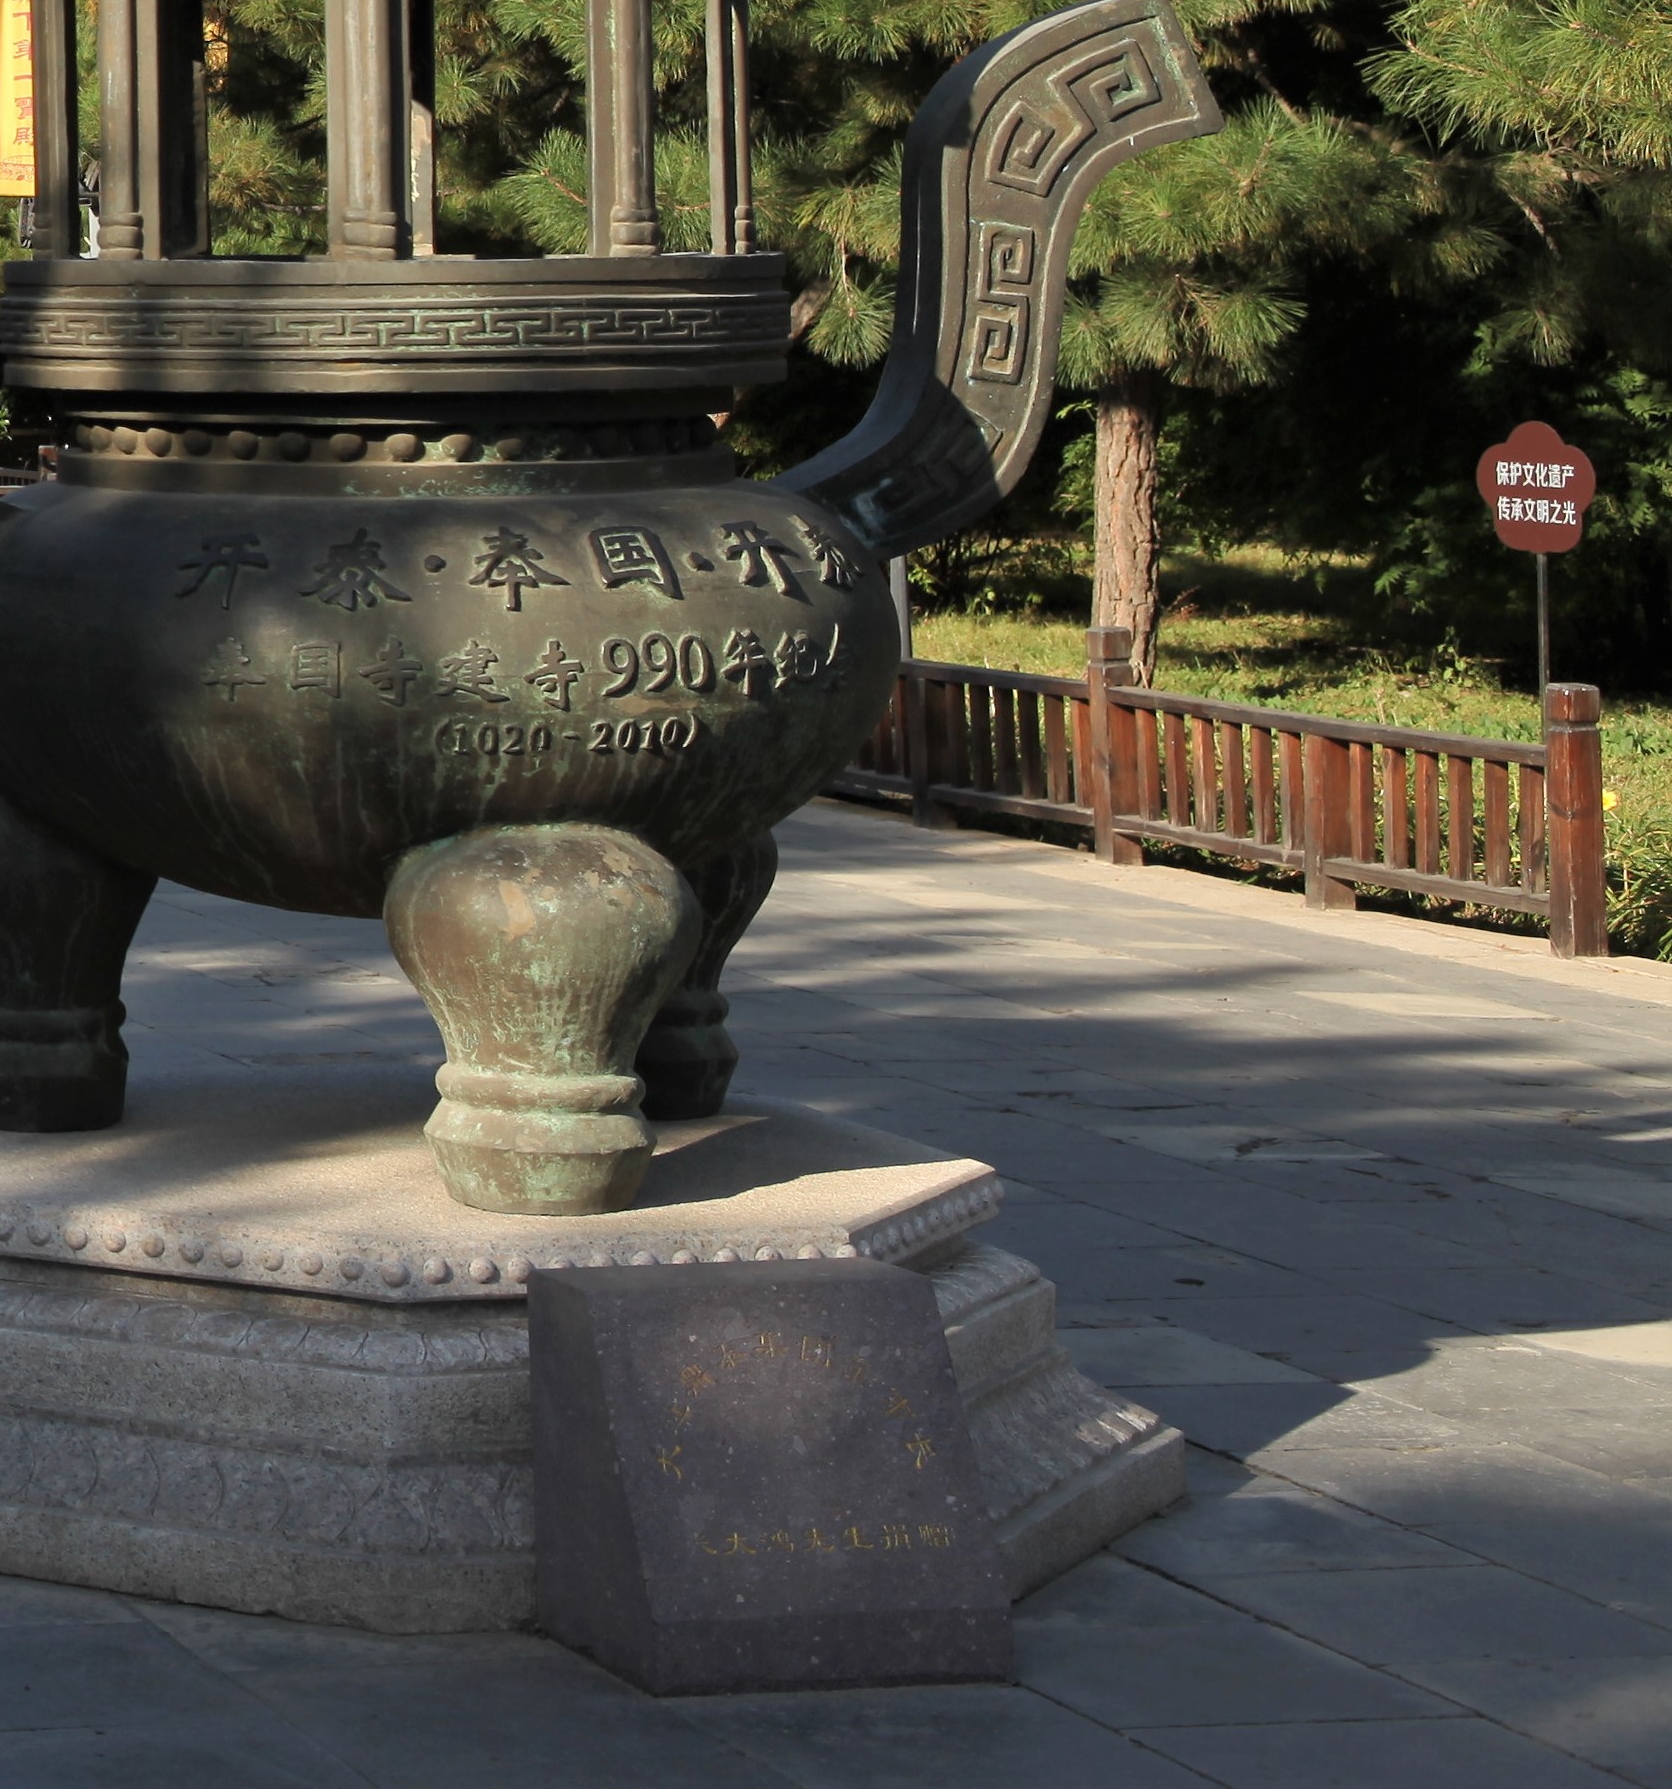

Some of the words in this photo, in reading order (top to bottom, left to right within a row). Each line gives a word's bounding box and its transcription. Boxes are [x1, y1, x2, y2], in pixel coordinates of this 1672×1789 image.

[1496, 461, 1575, 489] 保护文化遗产
[1497, 495, 1577, 526] 传承文明之光
